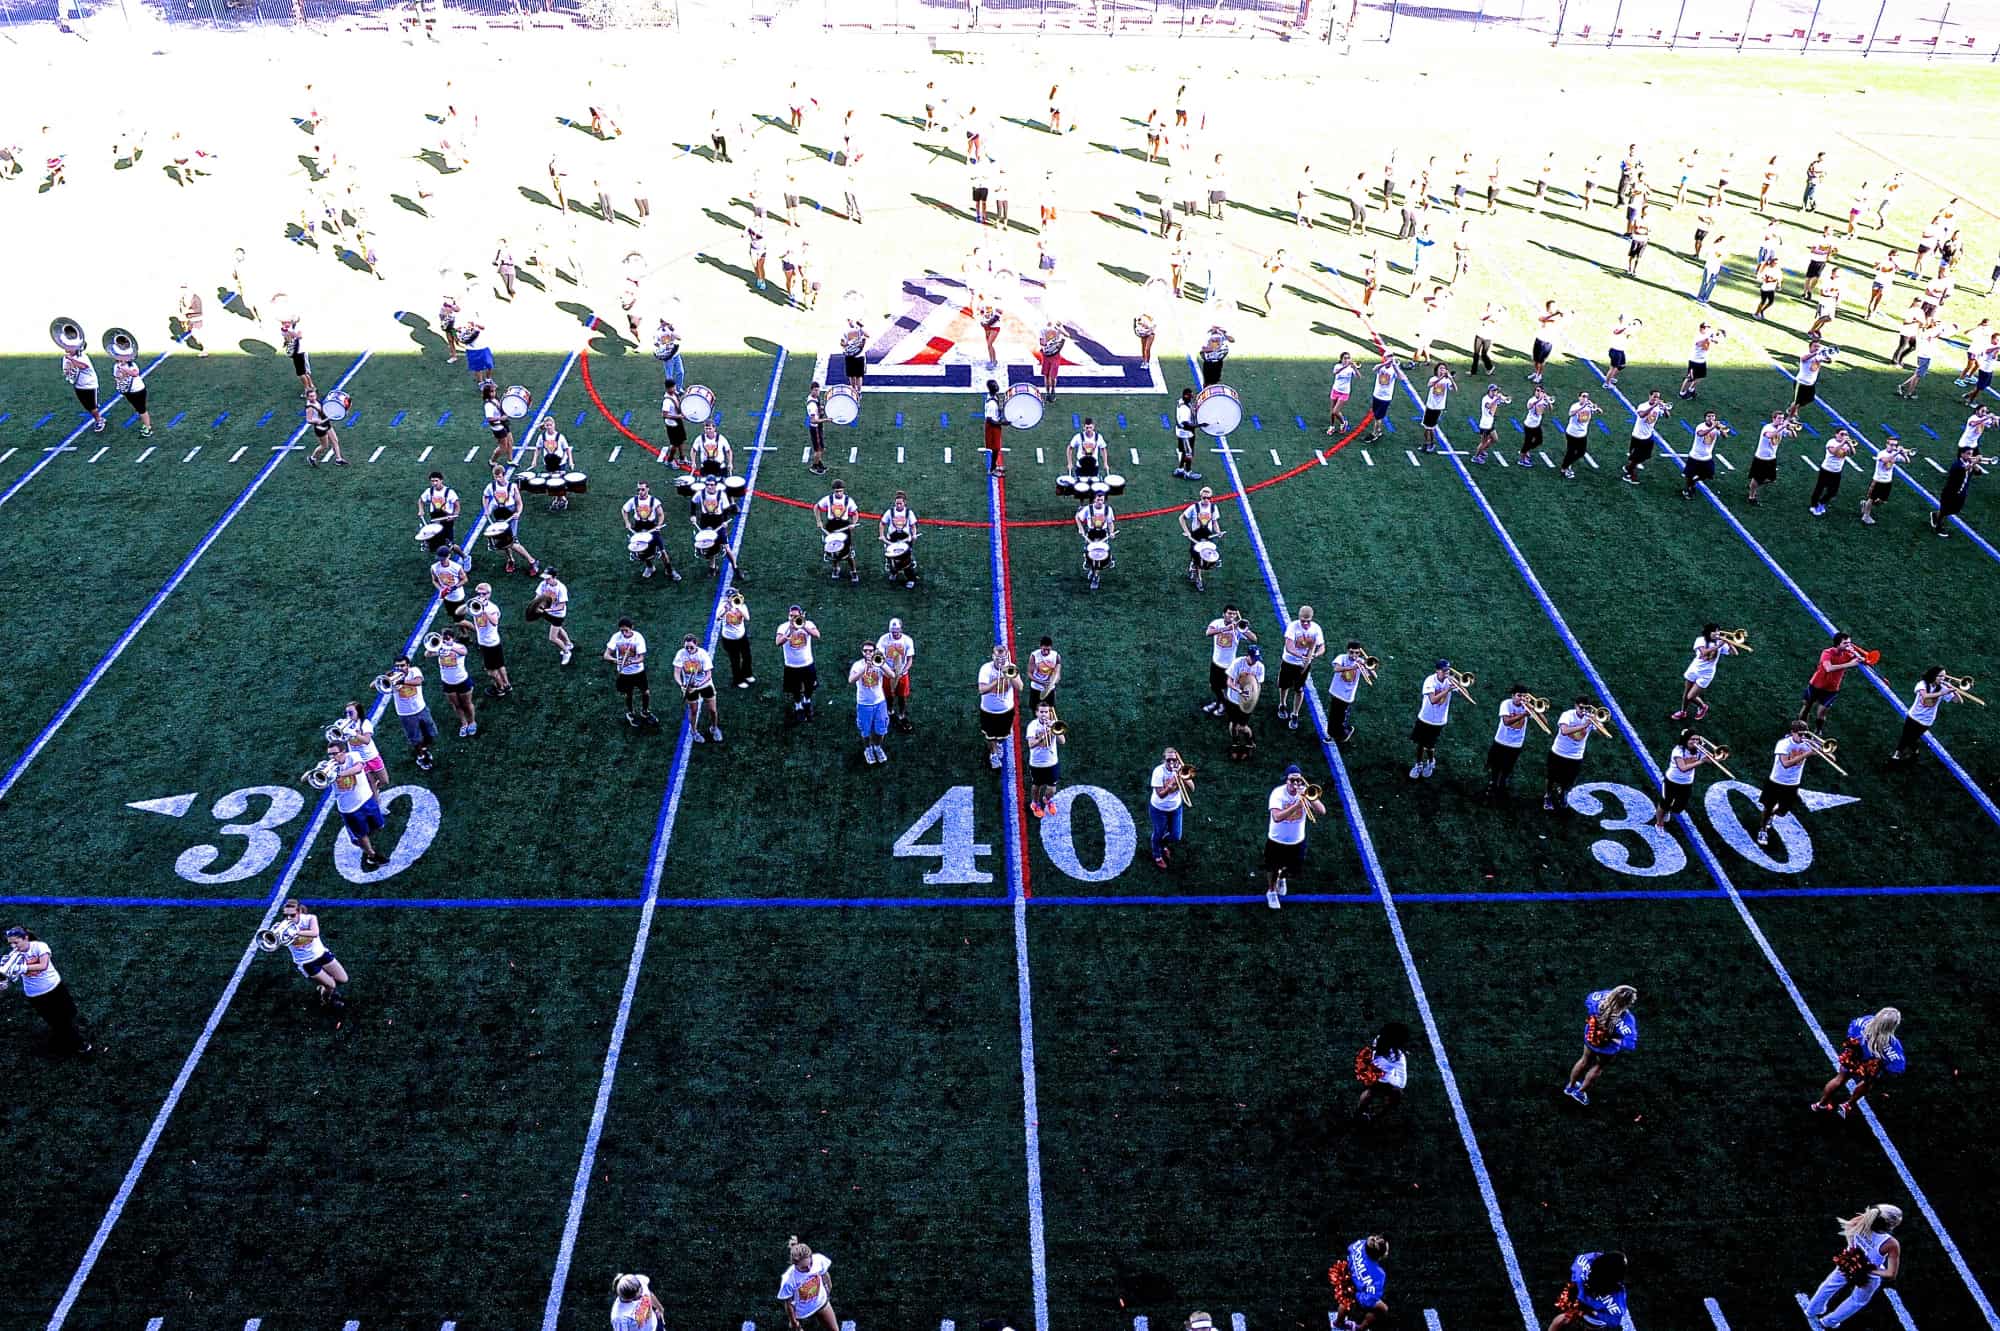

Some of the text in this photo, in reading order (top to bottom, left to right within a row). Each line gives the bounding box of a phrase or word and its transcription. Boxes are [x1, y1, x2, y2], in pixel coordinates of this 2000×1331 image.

[175, 785, 441, 884] 30
[893, 785, 1138, 884] 40
[1566, 781, 1813, 877] 30
